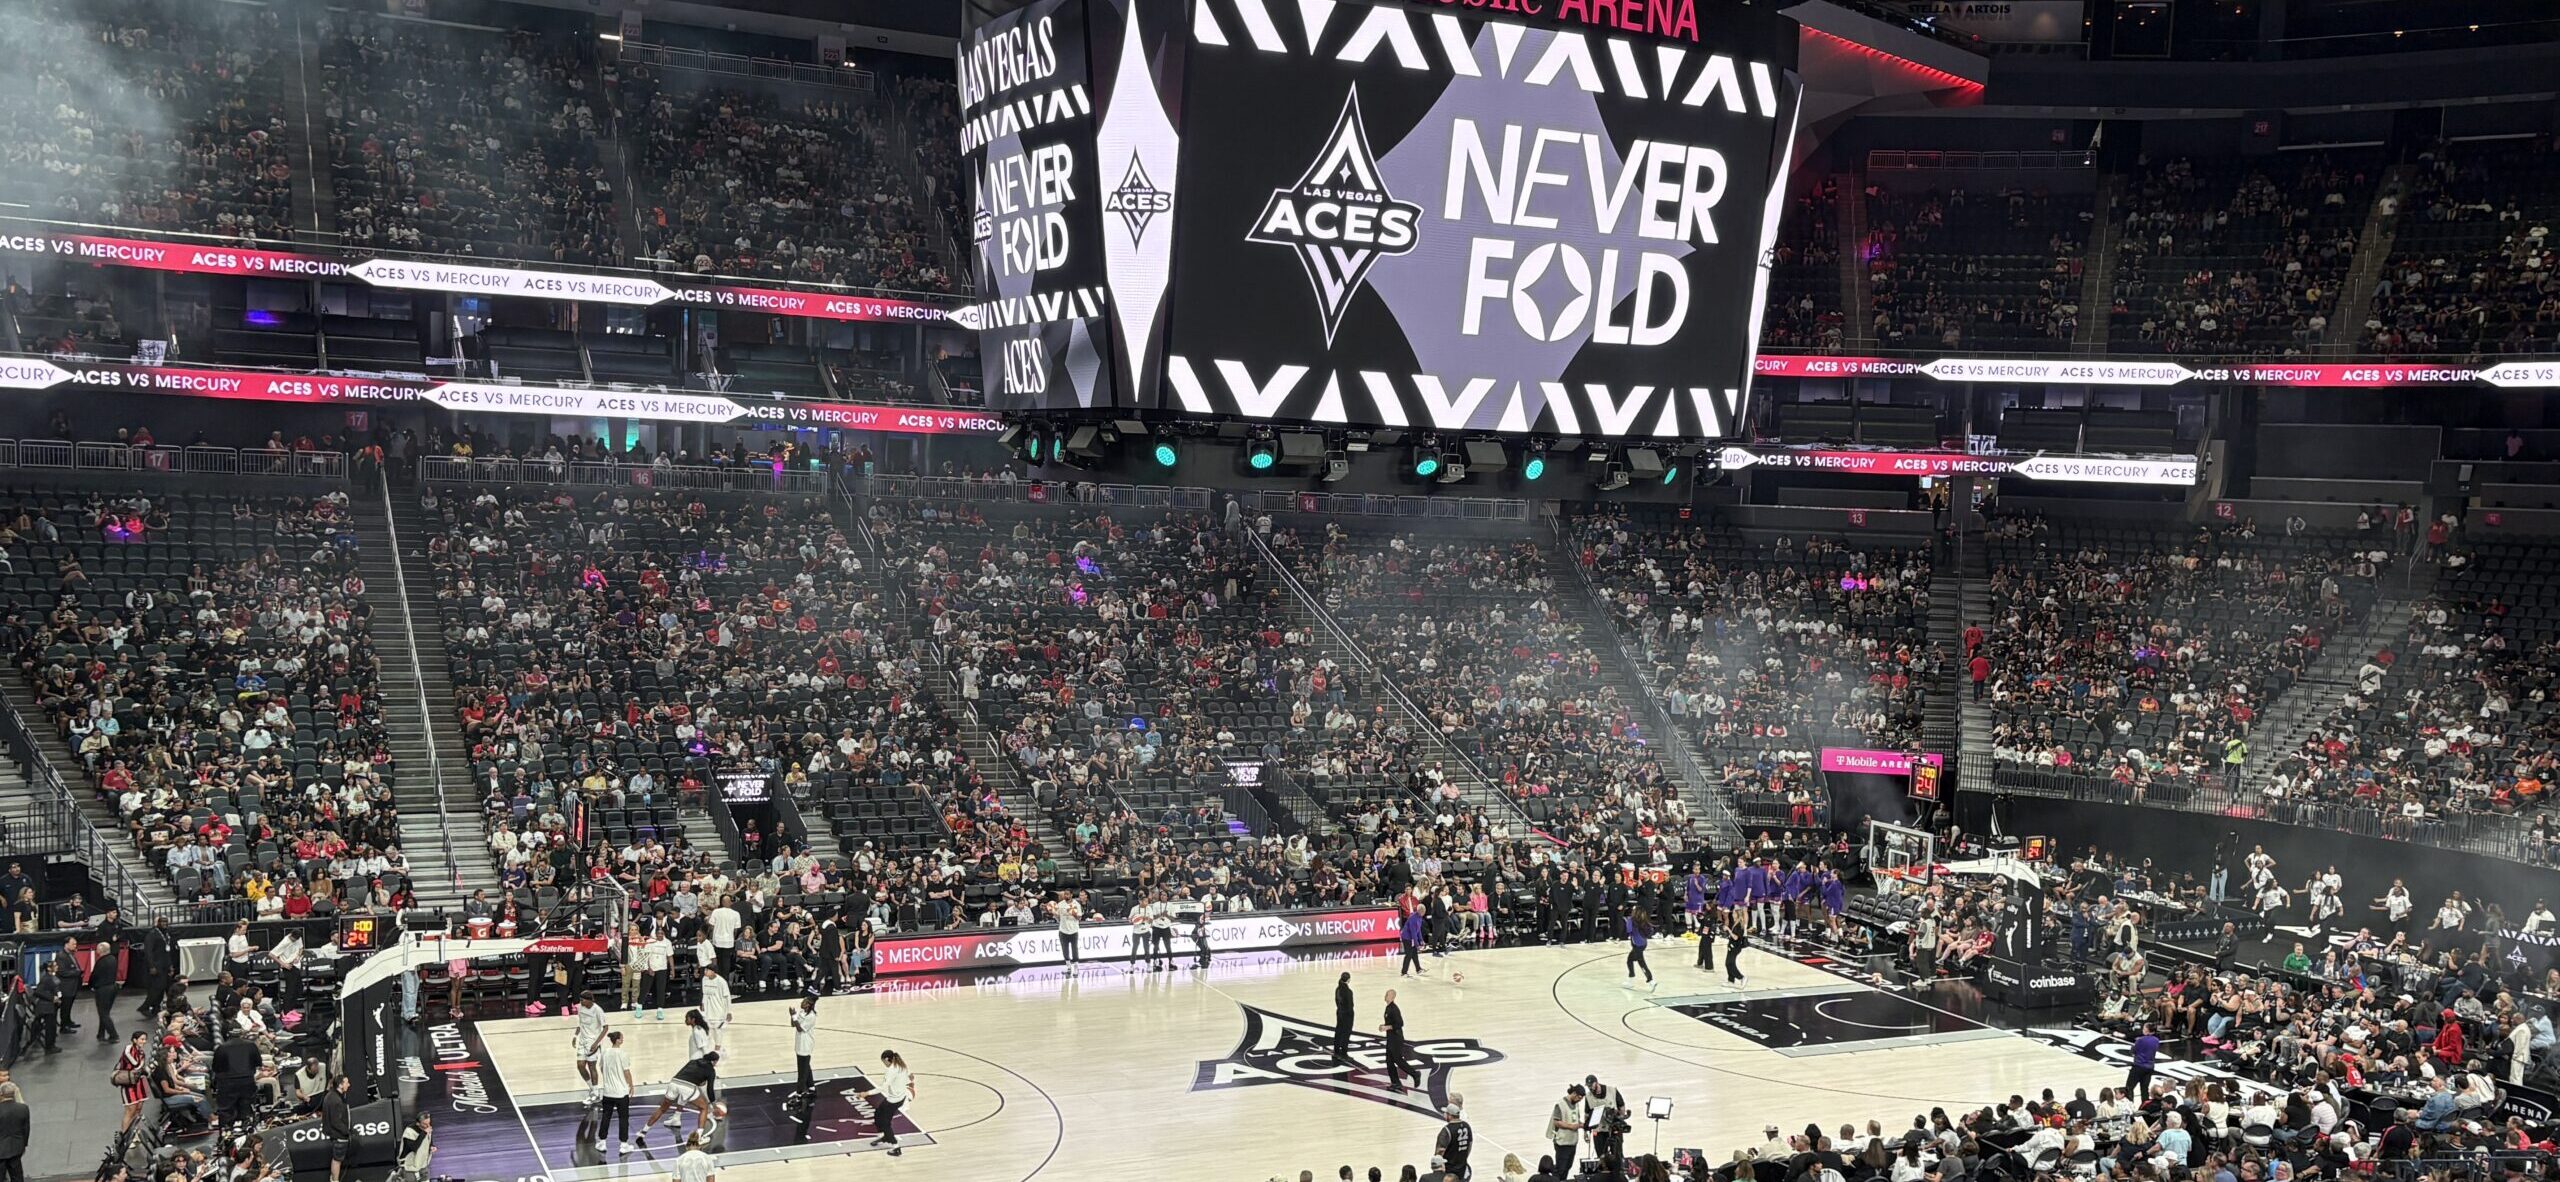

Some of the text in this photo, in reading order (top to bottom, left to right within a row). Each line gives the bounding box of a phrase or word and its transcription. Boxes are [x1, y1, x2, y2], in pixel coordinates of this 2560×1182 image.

[1966, 4, 2011, 14] ARTOIS
[1558, 0, 1699, 42] ARENA
[960, 16, 1056, 110] LAS VEGAS
[990, 144, 1076, 217] NEVER
[1444, 118, 1728, 244] NEVER
[1304, 186, 1383, 203] LAS VEGAS
[1107, 194, 1171, 211] ACES
[1262, 201, 1413, 248] ACES
[0, 236, 166, 262] ACES VS MERCURY
[1000, 212, 1069, 276] FOLD
[192, 252, 350, 277] ACES VS MERCURY
[364, 266, 510, 288] ACES VS MERCURY
[524, 278, 662, 299] ACES VS MERCURY
[1461, 237, 1690, 347] FOLD
[674, 289, 805, 310] ACES VS MERCURY
[826, 300, 949, 322] ACES VS MERCURY
[960, 311, 977, 323] AC
[1004, 338, 1046, 396] ACES
[1755, 360, 1788, 371] CURY
[1806, 361, 1922, 374] ACES VS MERCURY
[1932, 364, 2050, 378] ACES VS MERCURY
[0, 366, 55, 381] CURY
[72, 369, 241, 392] ACES VS MERCURY
[2060, 367, 2182, 380] ACES VS MERCURY
[2194, 369, 2321, 382] ACES VS MERCURY
[2342, 369, 2480, 382] ACES VS MERCURY
[2491, 368, 2553, 381] ACES VS
[267, 380, 424, 402] ACES VS MERCURY
[438, 388, 583, 408] ACES VS MERCURY
[597, 397, 735, 416] ACES VS MERCURY
[350, 414, 364, 426] 17
[748, 406, 879, 424] ACES VS MERCURY
[898, 415, 1009, 432] ACES VS MERCU
[151, 453, 164, 465] 17
[1758, 455, 1791, 466] ACES
[1795, 456, 1811, 468] VS
[1814, 457, 1876, 469] MERCURY
[1894, 458, 2014, 473] ACES VS MERCURY
[636, 472, 650, 484] 16
[2025, 464, 2148, 478] ACES VS MERCURY
[2161, 468, 2196, 479] ACES
[1304, 500, 1314, 510] 14
[2216, 504, 2232, 517] 12
[1852, 513, 1863, 524] 13
[1880, 759, 1911, 768] AREN
[737, 780, 765, 789] NEVER
[740, 788, 762, 796] FOLD
[1916, 776, 1932, 796] 24
[2028, 848, 2040, 858] 24
[354, 920, 373, 932] 1:00
[1258, 918, 1376, 938] ACES VS MERCURY
[1386, 917, 1400, 930] AC
[348, 932, 369, 946] 24
[478, 928, 486, 938] G
[1212, 926, 1246, 941] CURY
[889, 945, 962, 963] MERCURY
[975, 942, 1013, 958] ACES
[1018, 941, 1036, 954] VS
[2030, 975, 2076, 989] coinbase
[1710, 1015, 1769, 1041] WNBA
[428, 1022, 470, 1061] ULTRA
[1247, 1049, 1300, 1057] LAS
[1213, 1042, 1489, 1085] ACES
[2504, 1102, 2543, 1120] ARENA
[292, 1121, 390, 1142] coiase
[1457, 1128, 1468, 1140] 22
